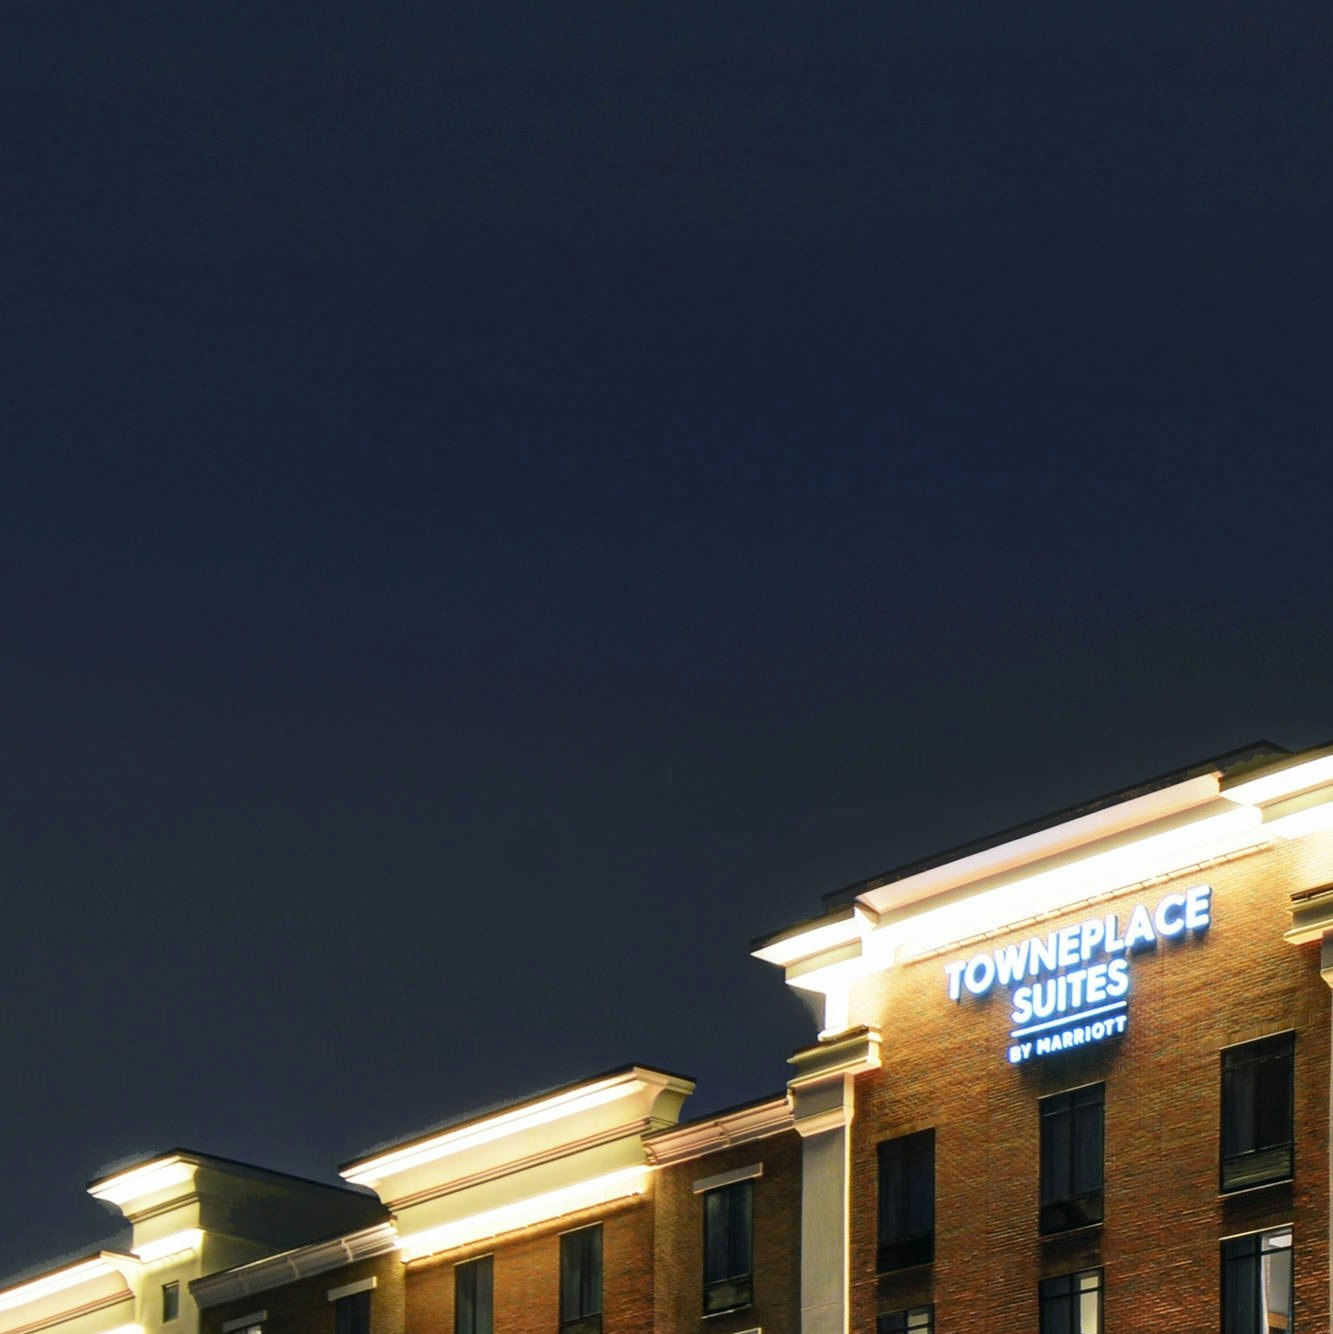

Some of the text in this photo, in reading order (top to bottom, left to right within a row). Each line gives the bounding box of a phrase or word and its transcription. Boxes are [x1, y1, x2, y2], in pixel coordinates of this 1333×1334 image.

[945, 885, 1211, 1001] TOWNEPLACE
[1010, 959, 1129, 1024] SUITES
[1008, 1015, 1127, 1063] BY MARRIOTT
